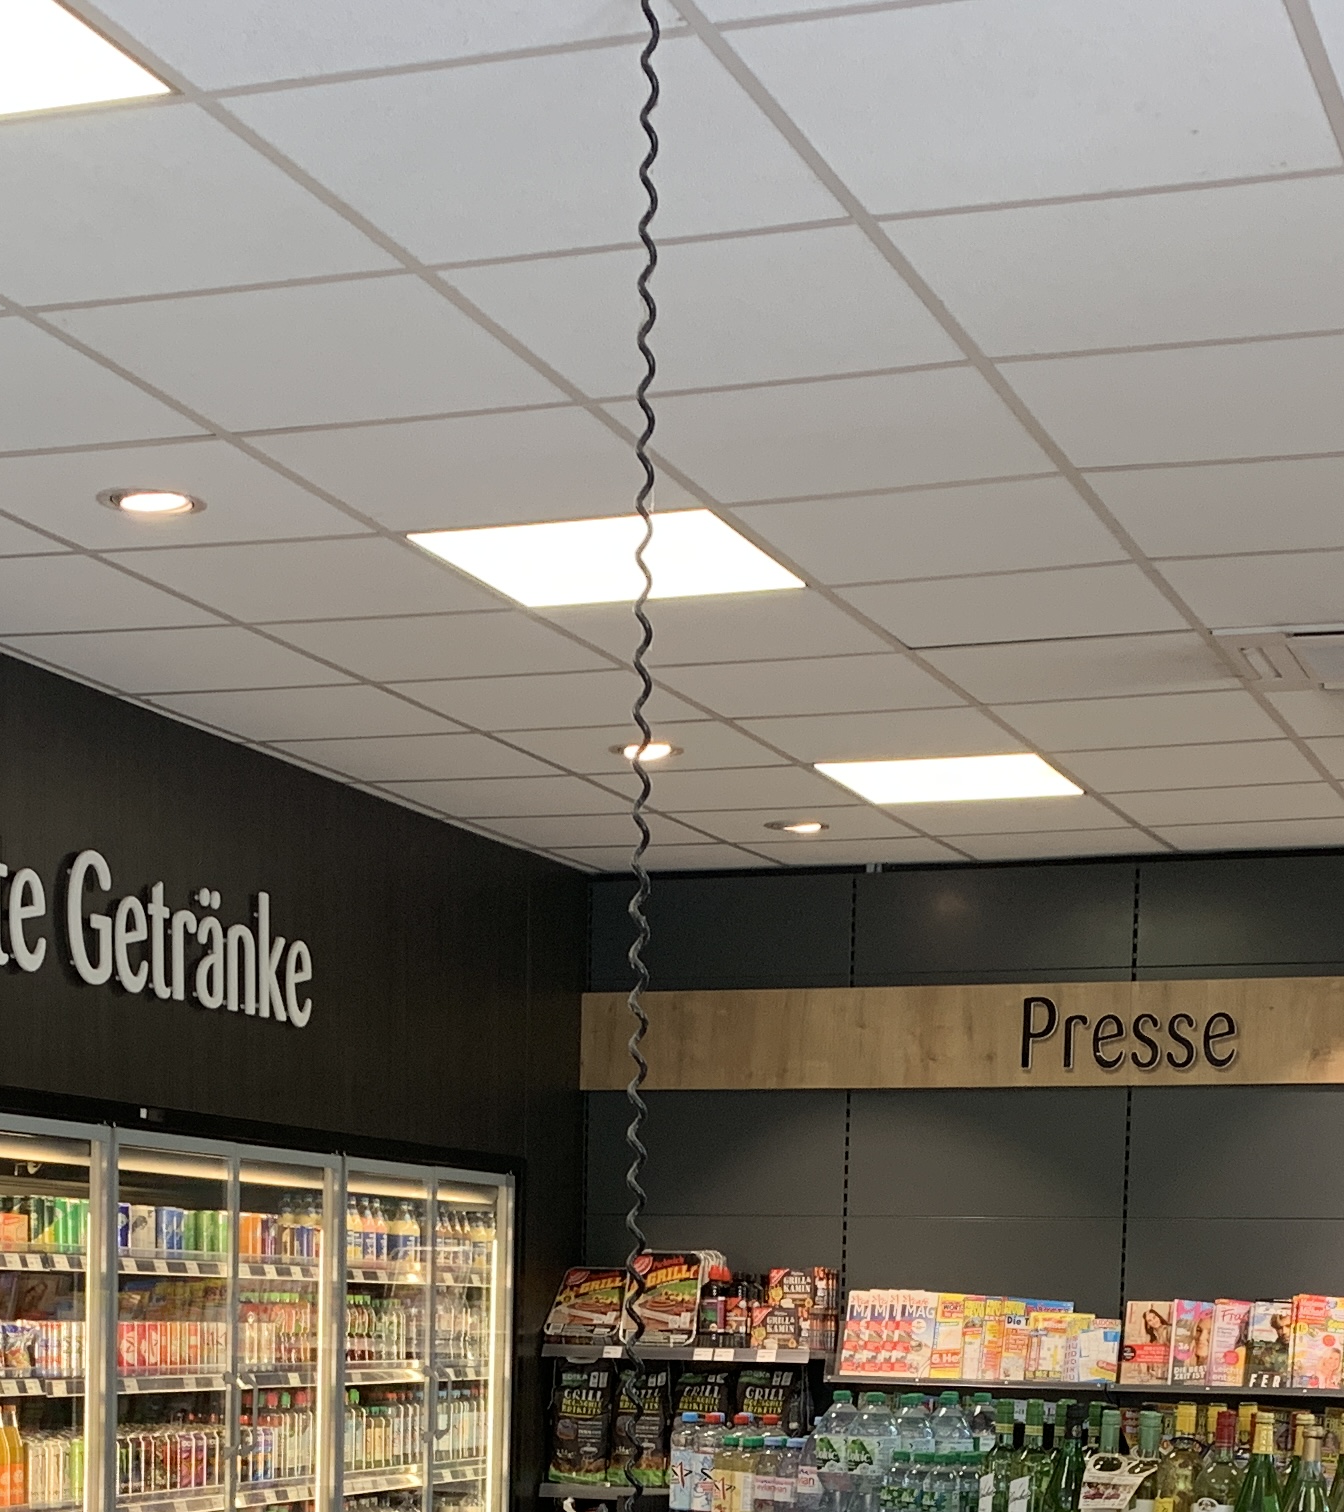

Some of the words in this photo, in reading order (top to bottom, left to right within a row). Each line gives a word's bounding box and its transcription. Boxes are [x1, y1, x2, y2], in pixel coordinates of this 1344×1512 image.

[67, 850, 312, 1027] Getränke
[1021, 996, 1238, 1069] Presse
[783, 1284, 812, 1294] KAMIN
[1007, 1317, 1021, 1326] Die
[766, 1324, 795, 1334] KAMIN
[564, 1389, 604, 1401] GRILL
[683, 1386, 722, 1399] GRILL
[745, 1386, 786, 1400] GRILL
